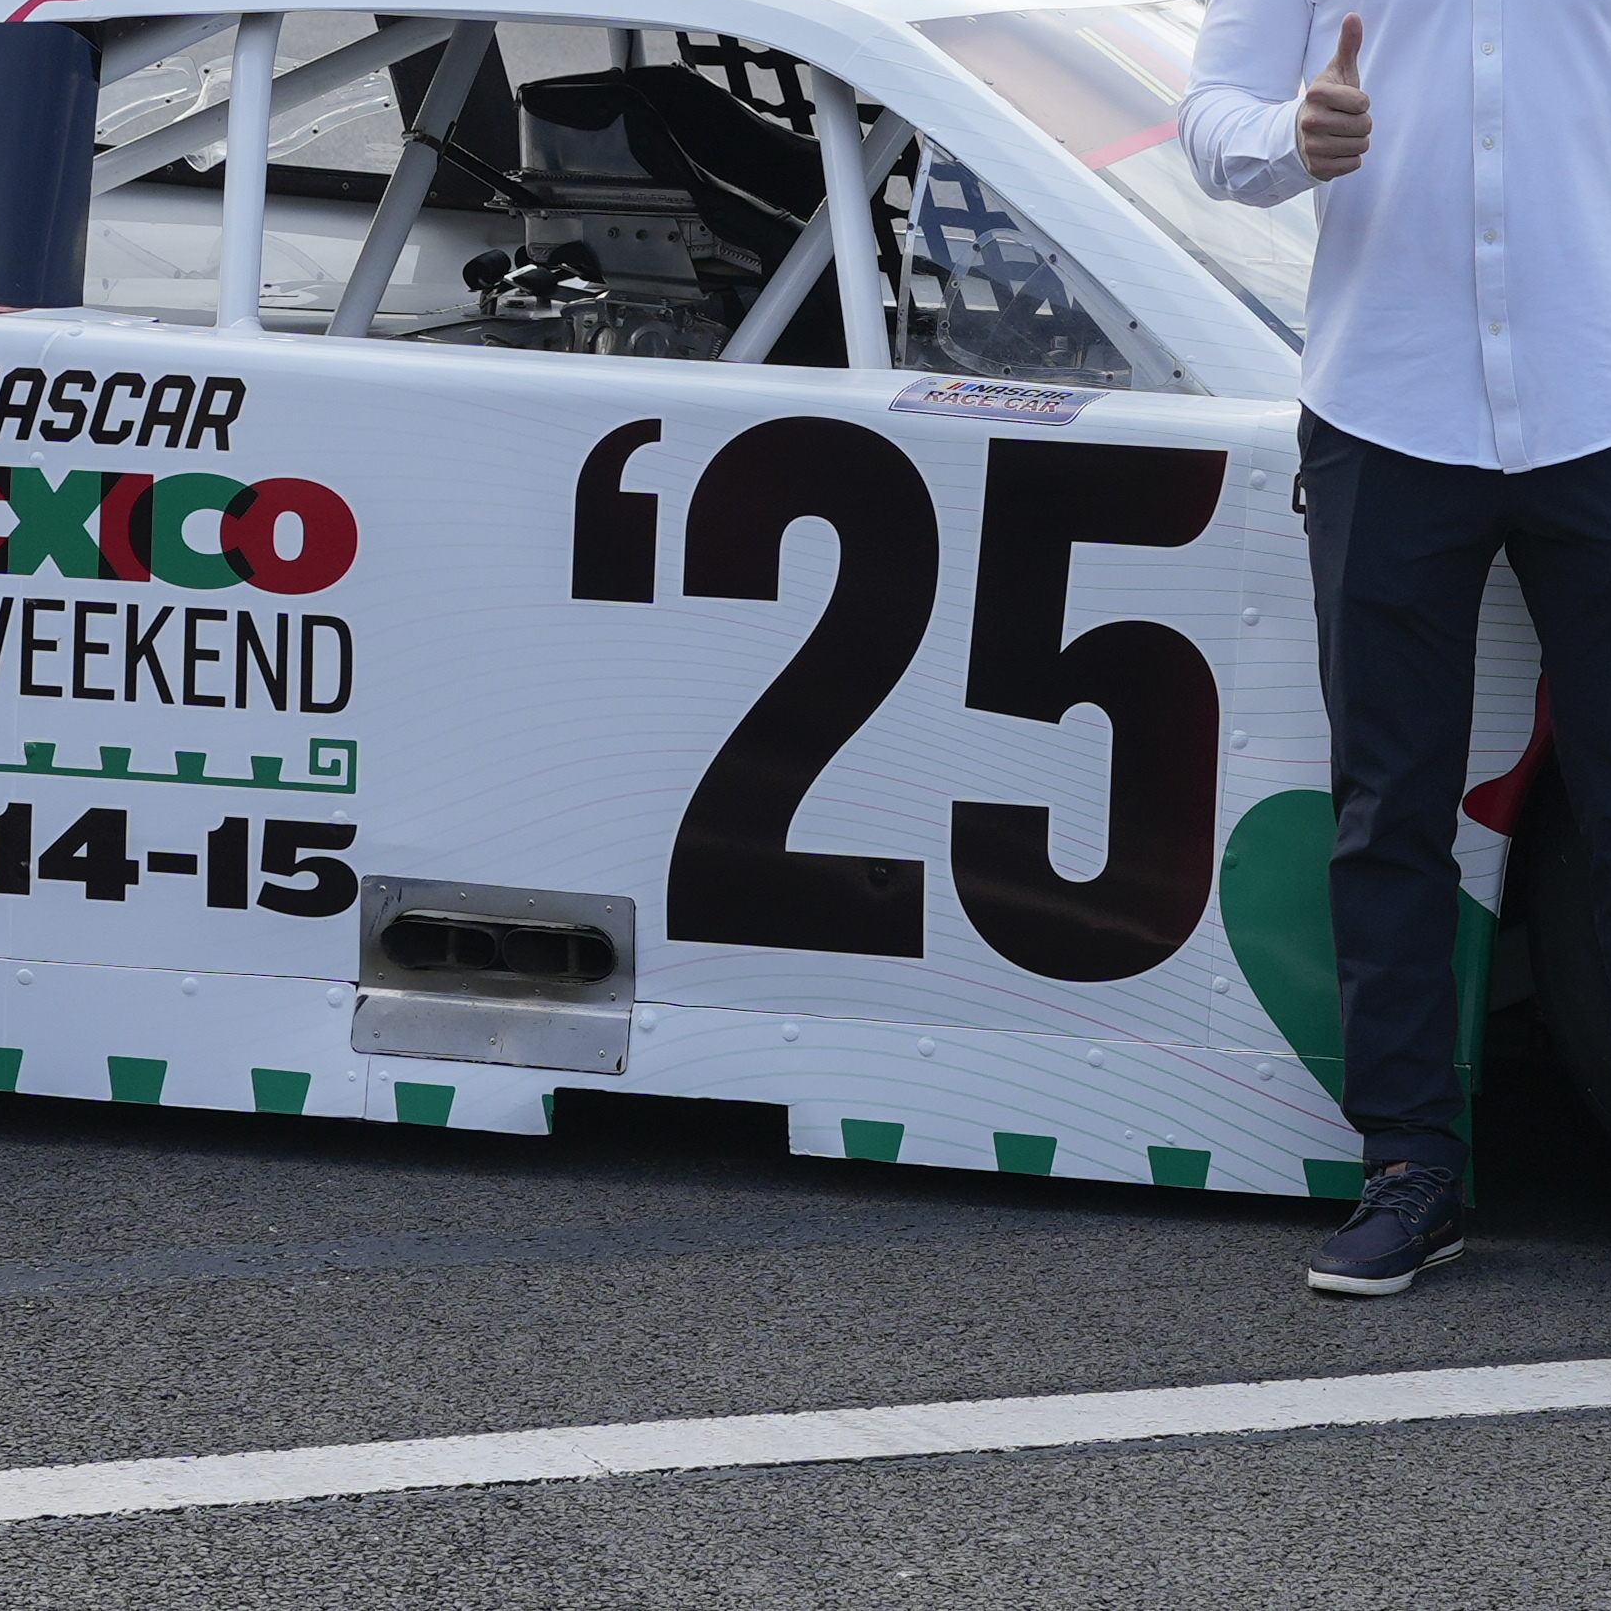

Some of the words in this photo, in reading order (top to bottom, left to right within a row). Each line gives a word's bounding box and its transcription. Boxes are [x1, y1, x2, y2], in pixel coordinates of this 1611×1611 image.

[921, 390, 995, 409] RACE
[1002, 398, 1062, 414] CAR
[969, 384, 1074, 401] NASCAR
